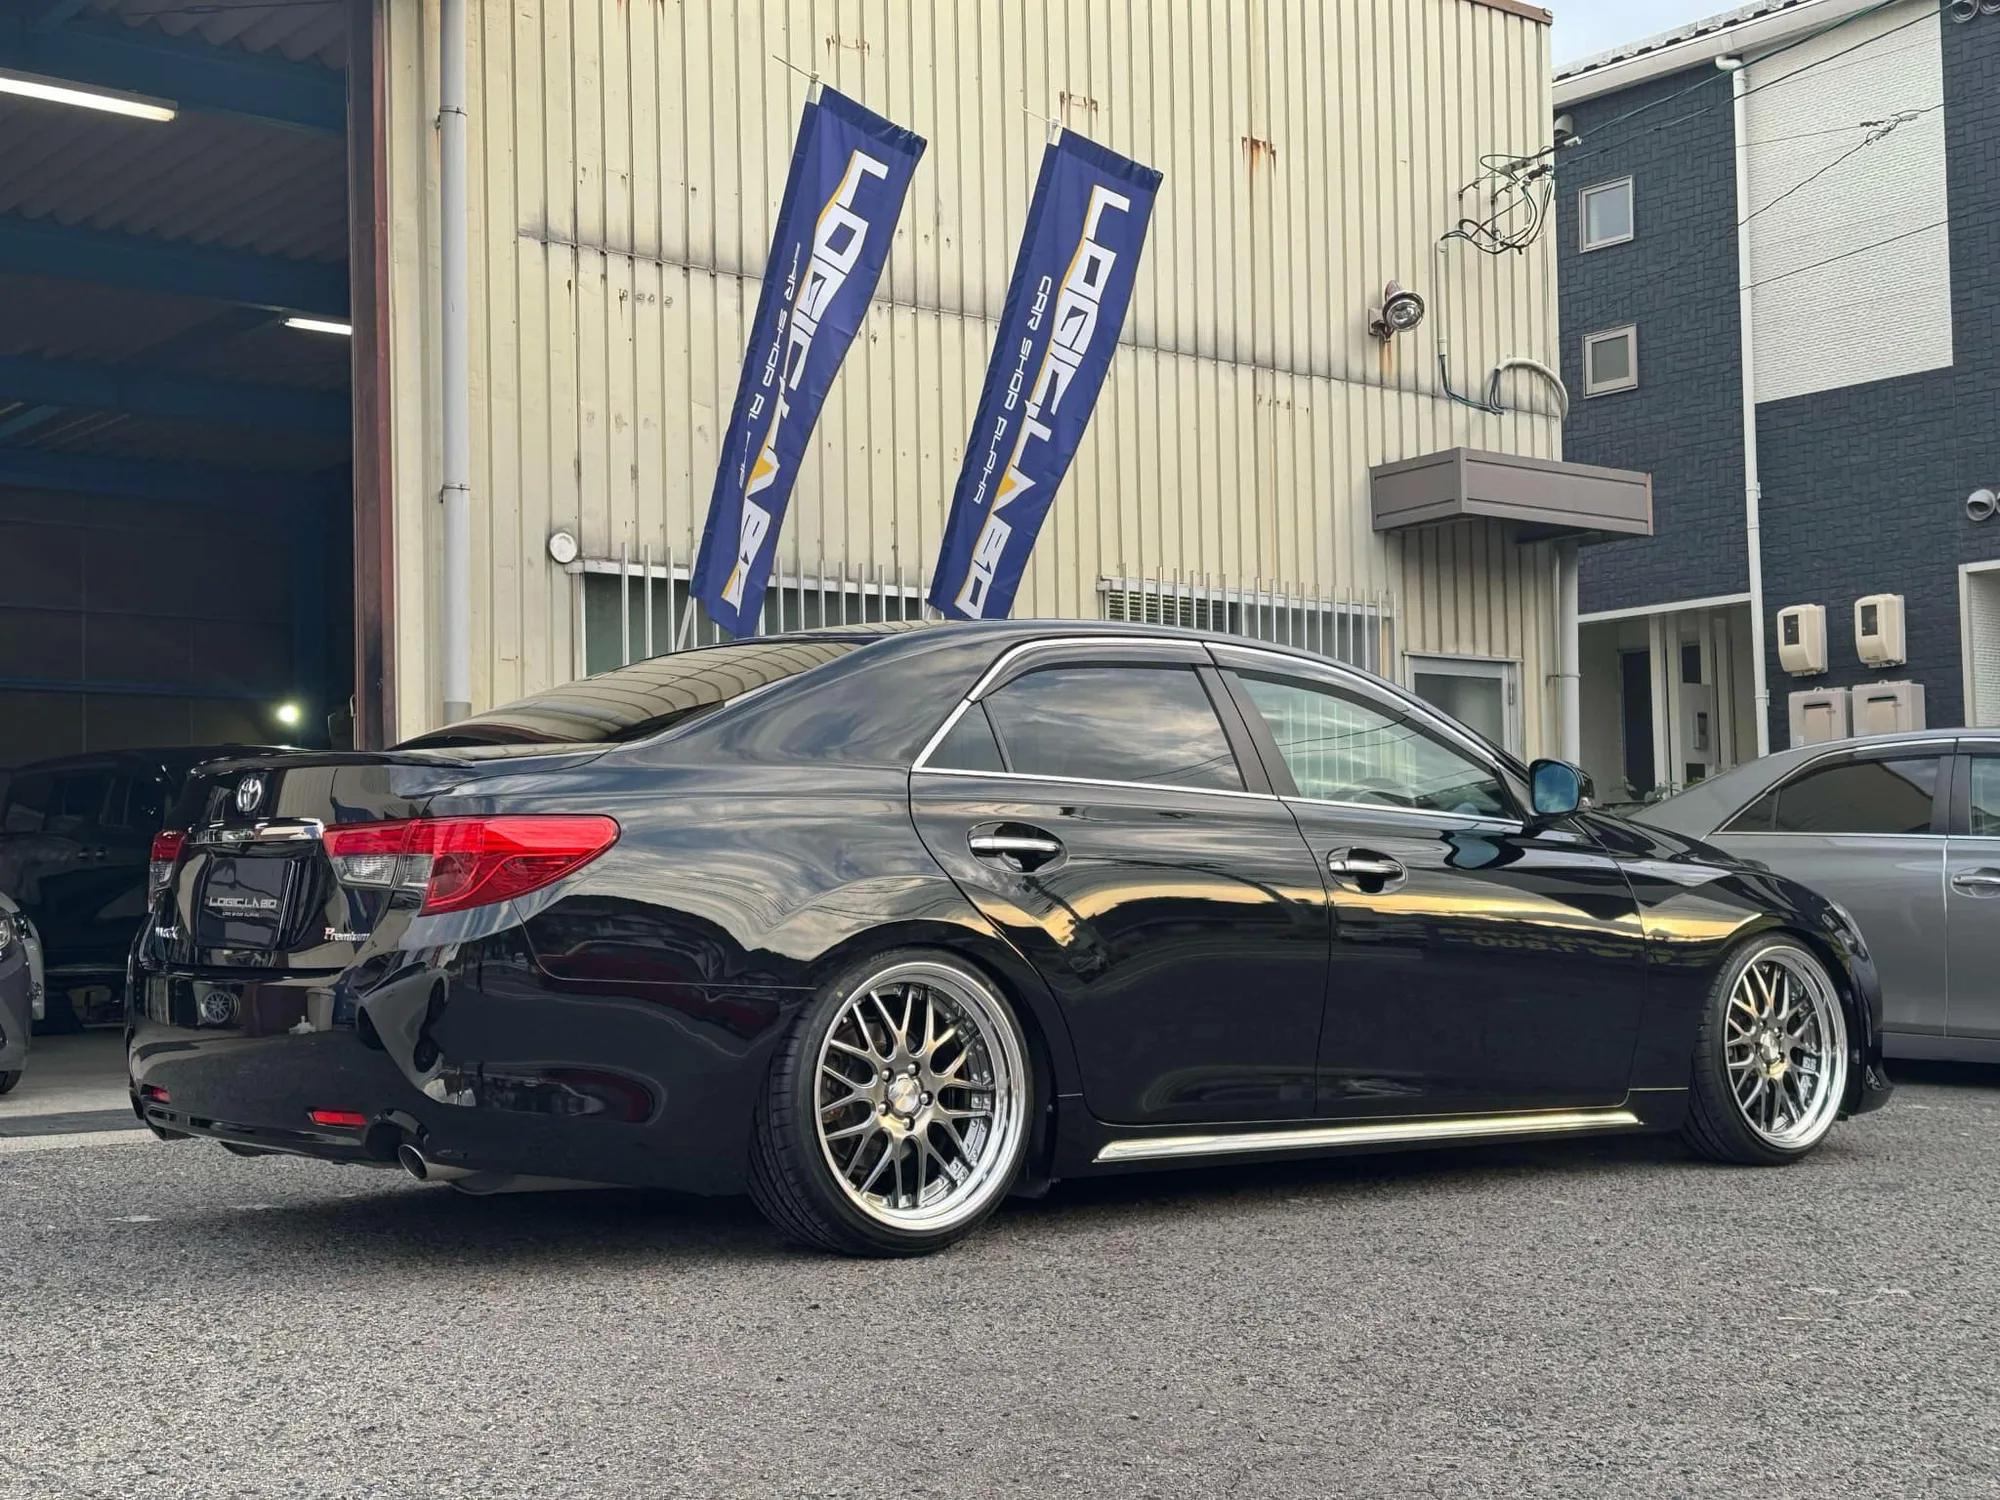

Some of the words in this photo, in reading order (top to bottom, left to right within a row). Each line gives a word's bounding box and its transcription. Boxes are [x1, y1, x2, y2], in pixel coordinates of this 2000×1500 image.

[1026, 275, 1052, 331] CAR
[762, 307, 788, 387] SHOP
[1004, 337, 1033, 411] SHOP
[973, 416, 1008, 505] ALPHA
